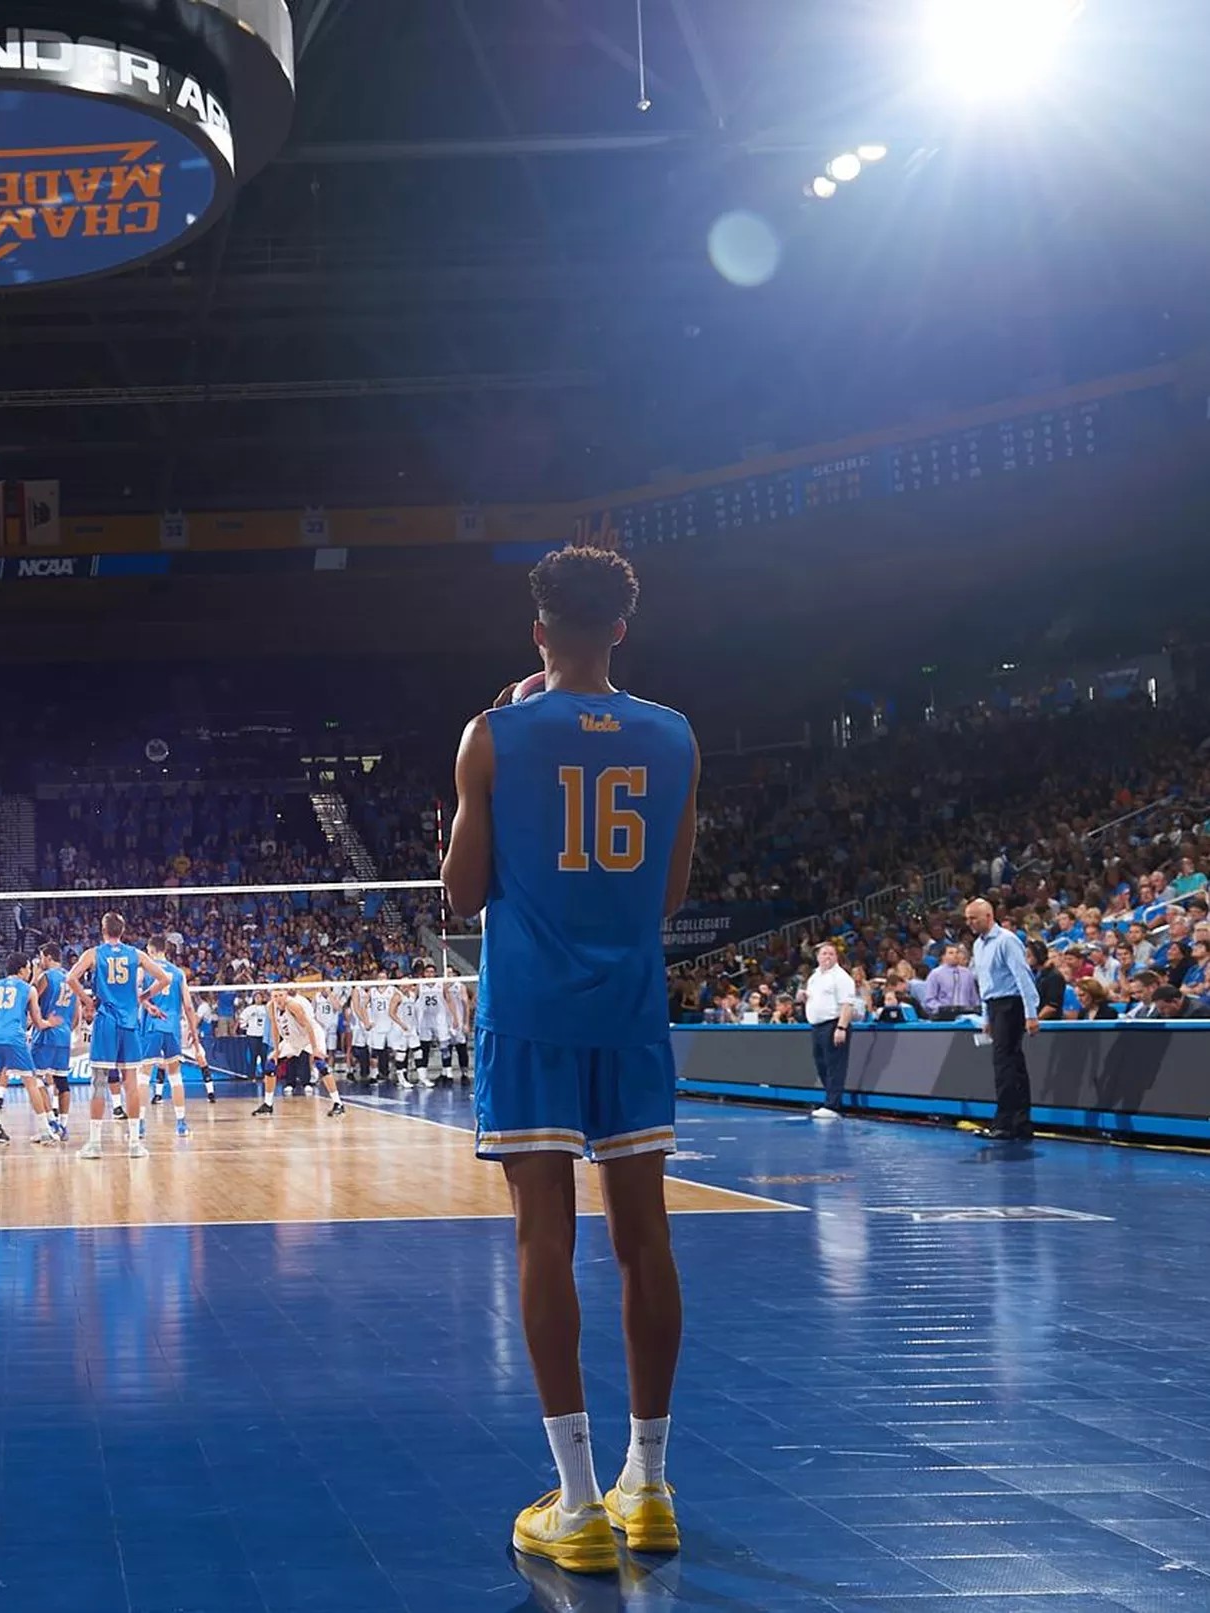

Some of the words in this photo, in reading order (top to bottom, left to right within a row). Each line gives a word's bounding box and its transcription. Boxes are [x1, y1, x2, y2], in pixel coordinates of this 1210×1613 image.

[18, 558, 76, 578] NCAA
[558, 766, 647, 872] 16
[675, 916, 732, 932] COLLEGIATE
[663, 931, 717, 945] MPIONSHIP
[106, 956, 130, 985] 15
[425, 996, 437, 1006] 25
